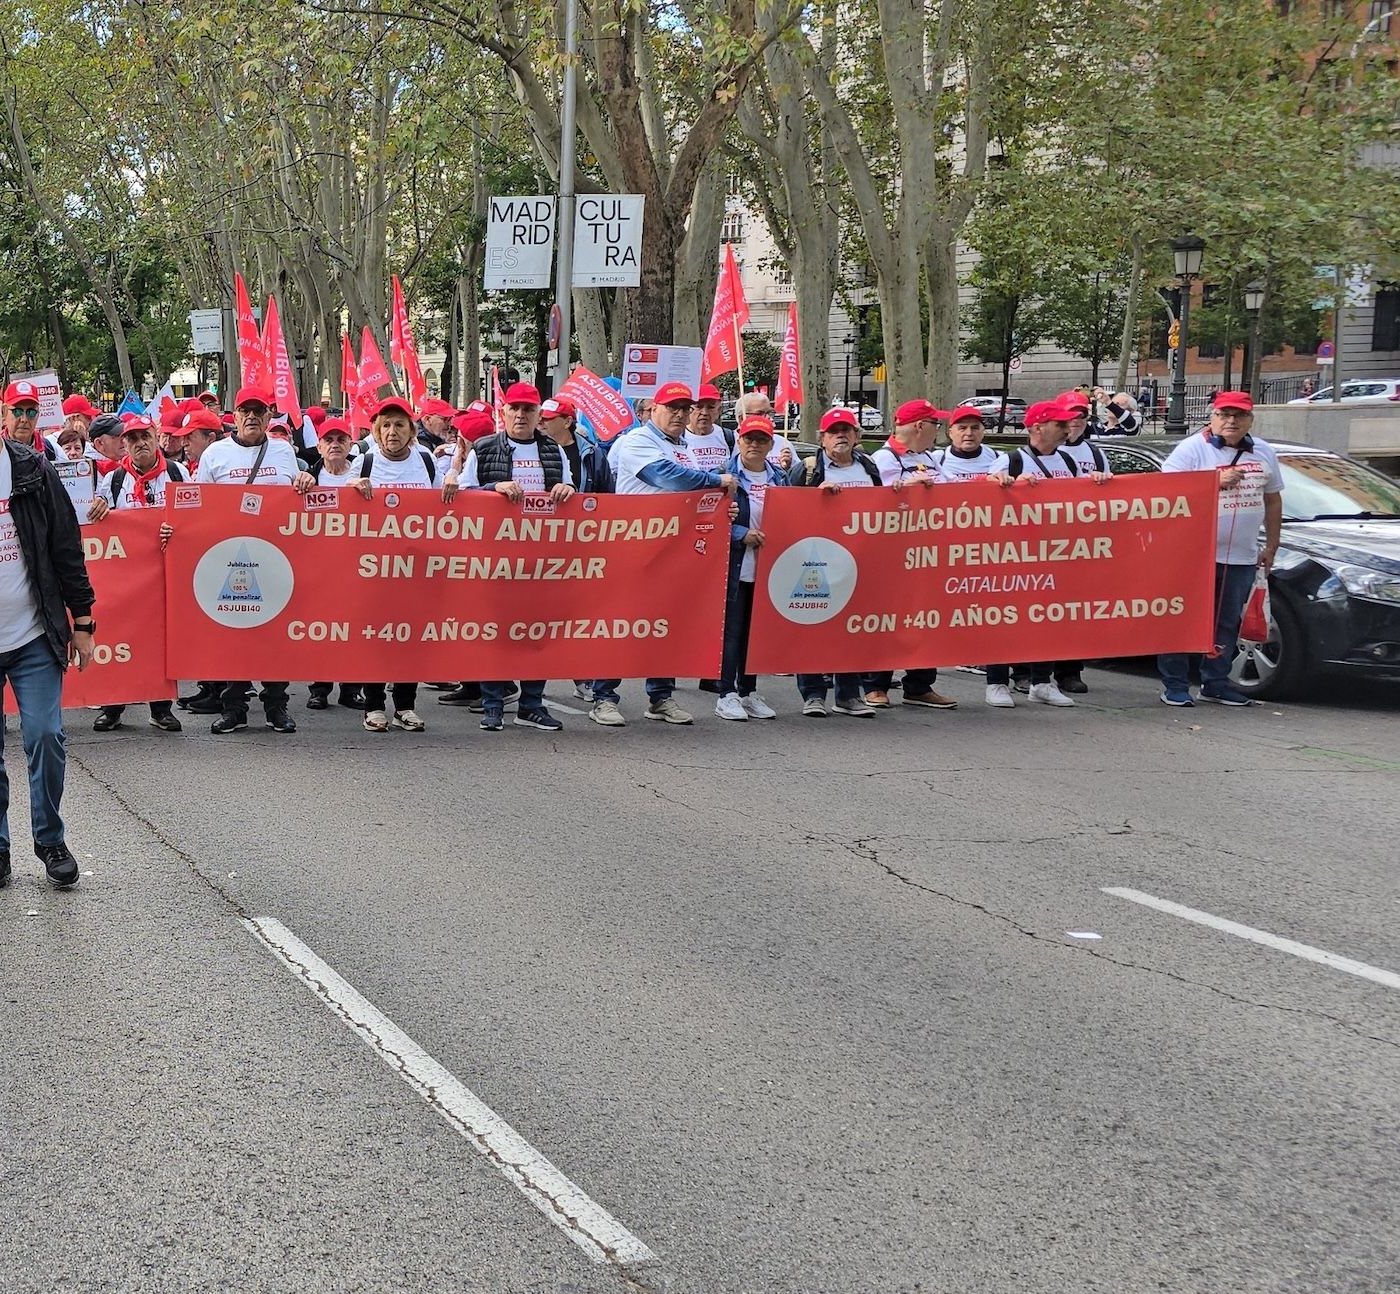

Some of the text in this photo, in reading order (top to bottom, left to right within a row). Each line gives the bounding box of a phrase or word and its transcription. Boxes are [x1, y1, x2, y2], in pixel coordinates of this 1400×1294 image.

[491, 201, 552, 223] MAD
[579, 200, 631, 221] CUL
[512, 224, 551, 245] RID
[587, 223, 621, 244] TU
[488, 246, 519, 270] ES
[605, 245, 637, 267] RA
[578, 374, 629, 417] ASJUBI40
[307, 492, 336, 504] NO+
[525, 497, 553, 508] NO+
[278, 510, 680, 543] JUBILACIÓN ANTICIPADA
[842, 495, 1192, 536] JUBILACIÓN ANTICIPADA
[904, 536, 1113, 570] SIN PENALIZAR
[357, 554, 607, 580] SIN PENALIZAR
[944, 573, 1056, 594] CATALUNYA
[217, 604, 261, 612] ASJUBI40
[846, 596, 1185, 633] CON +40 AÑOS COTIZADOS
[287, 617, 669, 642] CON +40 AÑOS COTIZADOS
